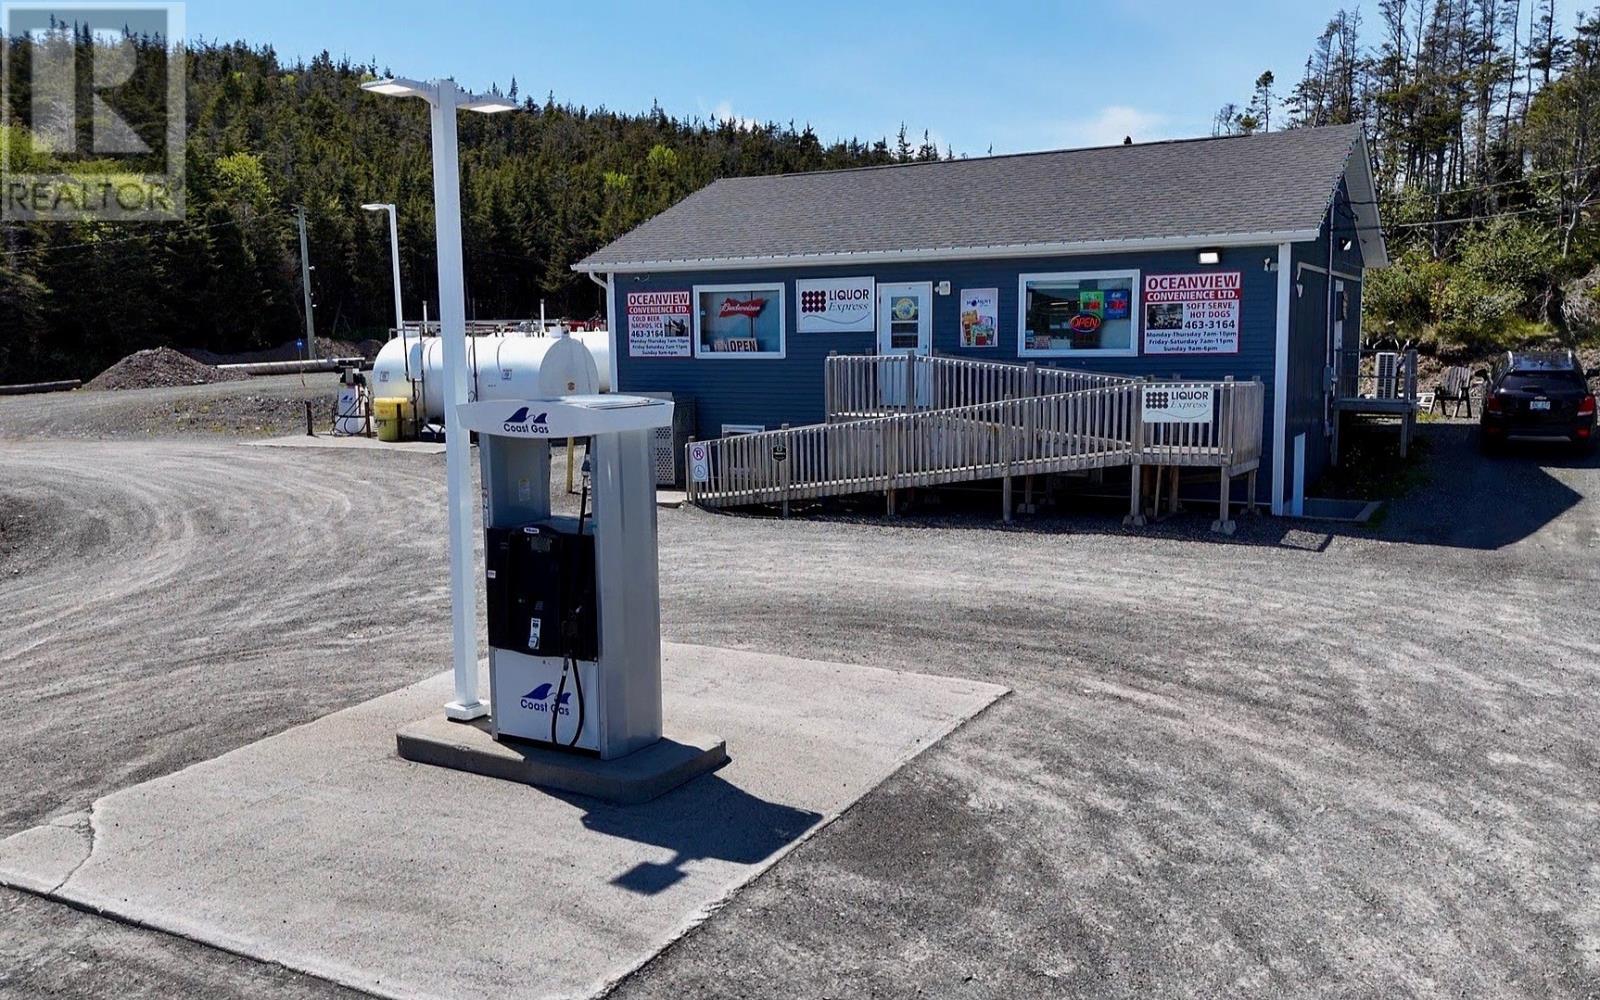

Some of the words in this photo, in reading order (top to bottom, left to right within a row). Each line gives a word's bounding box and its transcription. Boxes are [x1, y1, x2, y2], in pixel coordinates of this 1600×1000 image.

[1148, 275, 1238, 290] OCEANVIEW
[629, 294, 688, 305] OCEANVIEW
[829, 289, 869, 301] LIQUOR
[1147, 291, 1215, 302] CONVENIENCE
[1217, 290, 1239, 300] LTD.
[629, 306, 673, 314] CONVENIENCE
[675, 305, 689, 313] LTD.
[828, 302, 870, 313] Express
[1187, 302, 1206, 310] SOFT
[1208, 302, 1235, 310] SERVE,
[1208, 310, 1231, 318] DOGS
[1073, 319, 1098, 328] OPEN
[1184, 320, 1236, 329] 463-3164
[631, 330, 664, 338] 463-3164
[730, 340, 756, 352] OPEN
[1171, 391, 1208, 400] LIQUOR
[1170, 401, 1207, 409] Express
[503, 423, 529, 433] Coast
[531, 424, 549, 434] Gas
[520, 699, 548, 713] Coast
